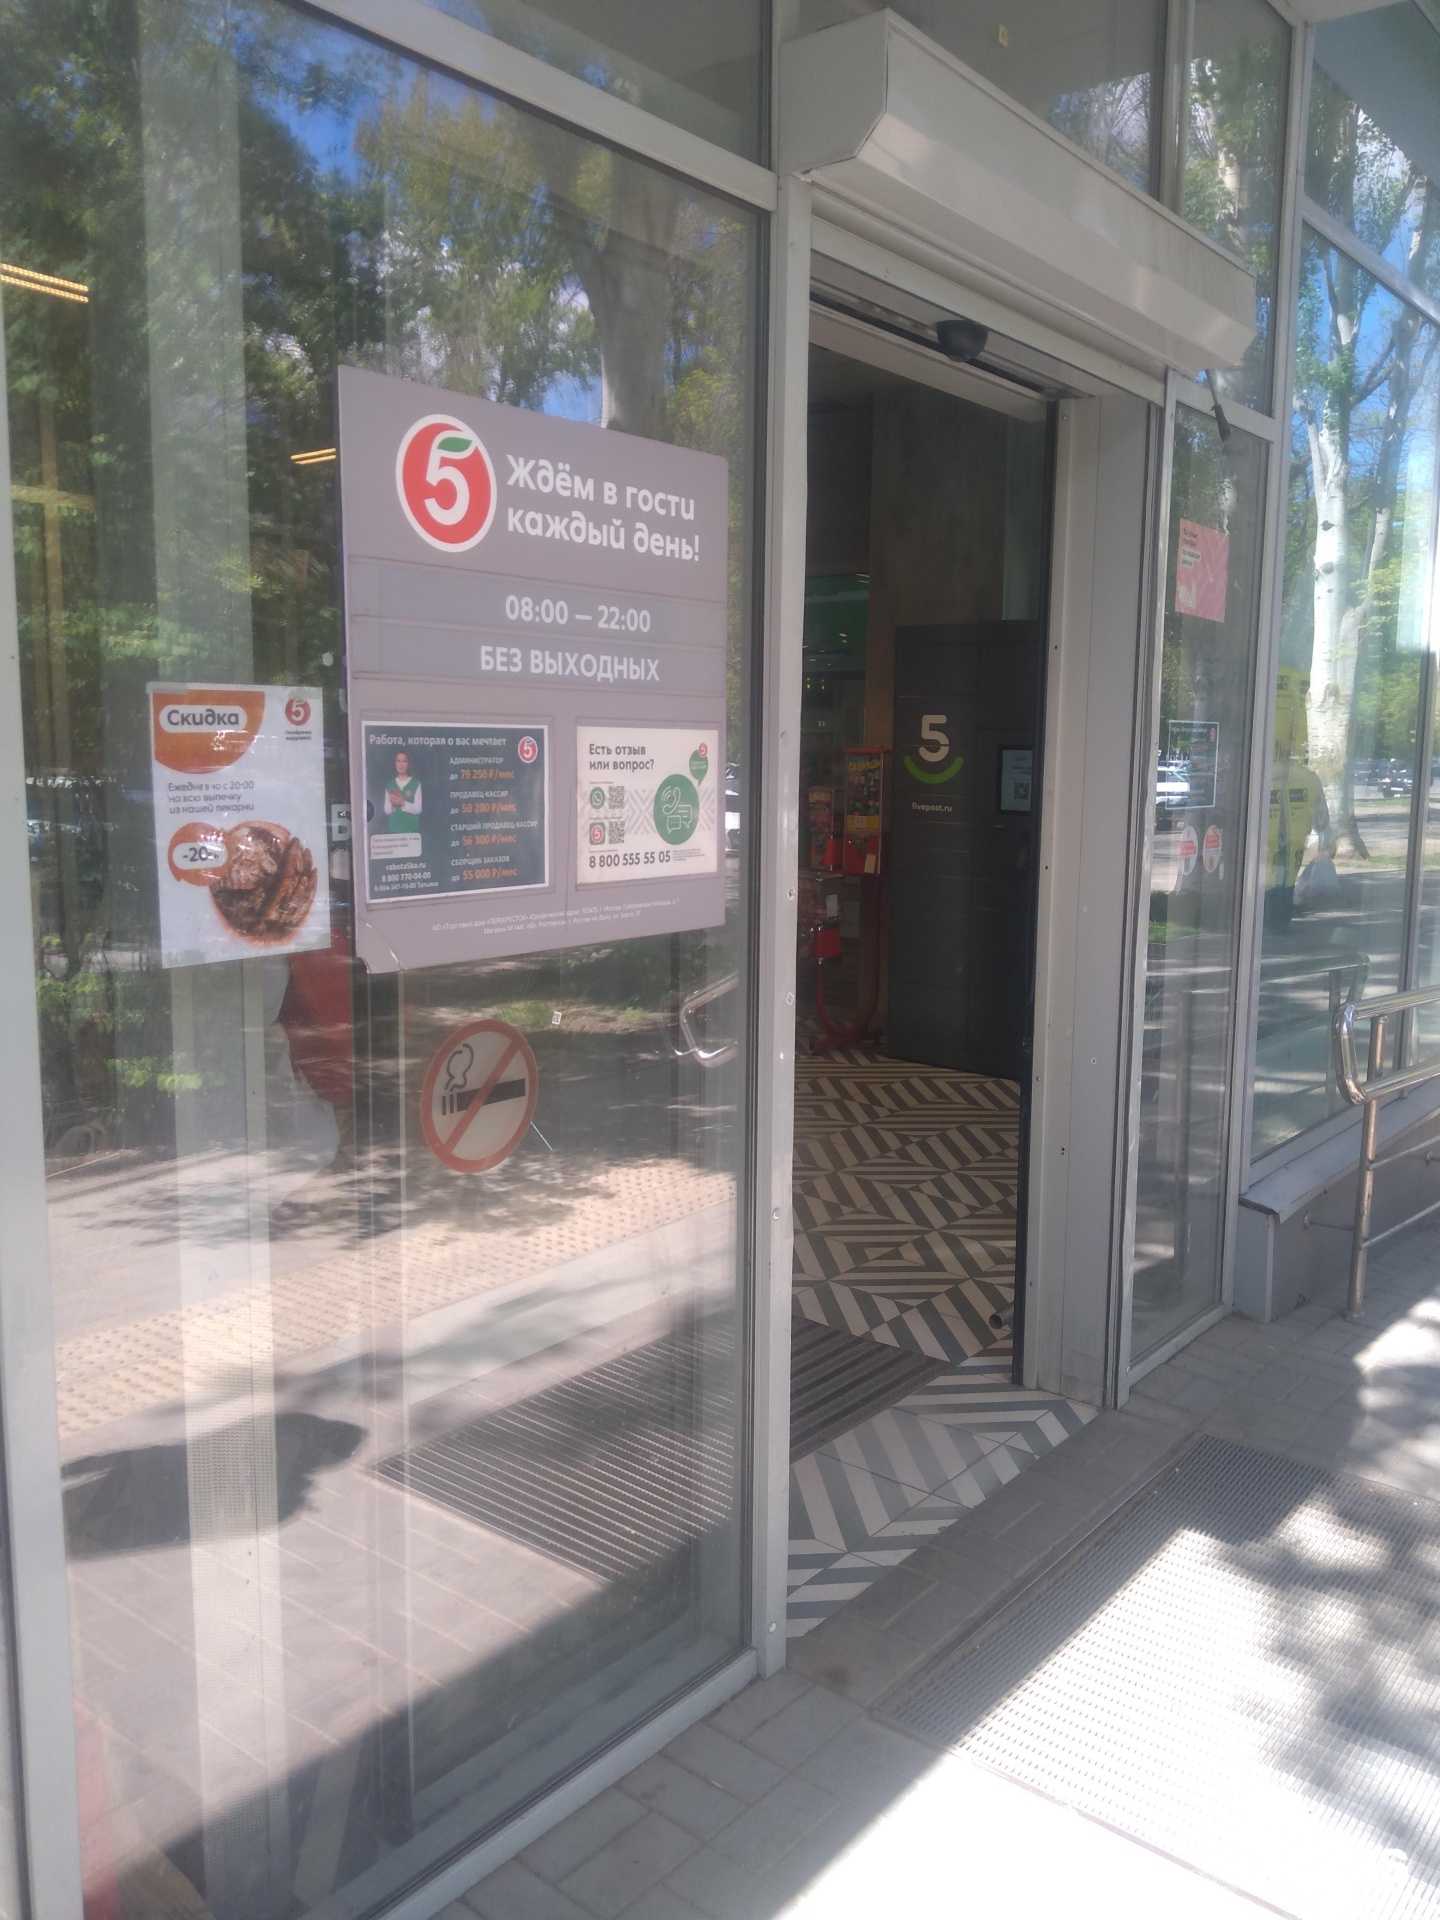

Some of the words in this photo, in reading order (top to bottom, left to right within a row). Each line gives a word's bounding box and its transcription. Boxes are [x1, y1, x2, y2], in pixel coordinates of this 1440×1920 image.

[506, 454, 594, 501] Ждём
[604, 482, 617, 504] в
[625, 485, 695, 521] гости
[507, 507, 624, 550] каждый
[633, 522, 700, 562] день!
[505, 595, 568, 625] 08:00
[597, 605, 651, 633] 22:00
[480, 645, 522, 672] БЕЗ
[529, 649, 660, 682] ВЫХОДНЫХ
[167, 709, 239, 727] Скидка
[369, 734, 406, 746] Работа,
[407, 737, 446, 747] которая
[448, 738, 454, 746] о
[455, 738, 470, 746] вас
[589, 743, 612, 755] Есть
[615, 745, 646, 756] отзыв
[919, 714, 950, 762] 5
[589, 760, 609, 770] или
[612, 759, 654, 773] вопрос?
[589, 855, 596, 869] 8
[599, 854, 620, 868] 800
[622, 852, 641, 866] 555
[643, 851, 656, 864] 55
[658, 850, 671, 864] 05
